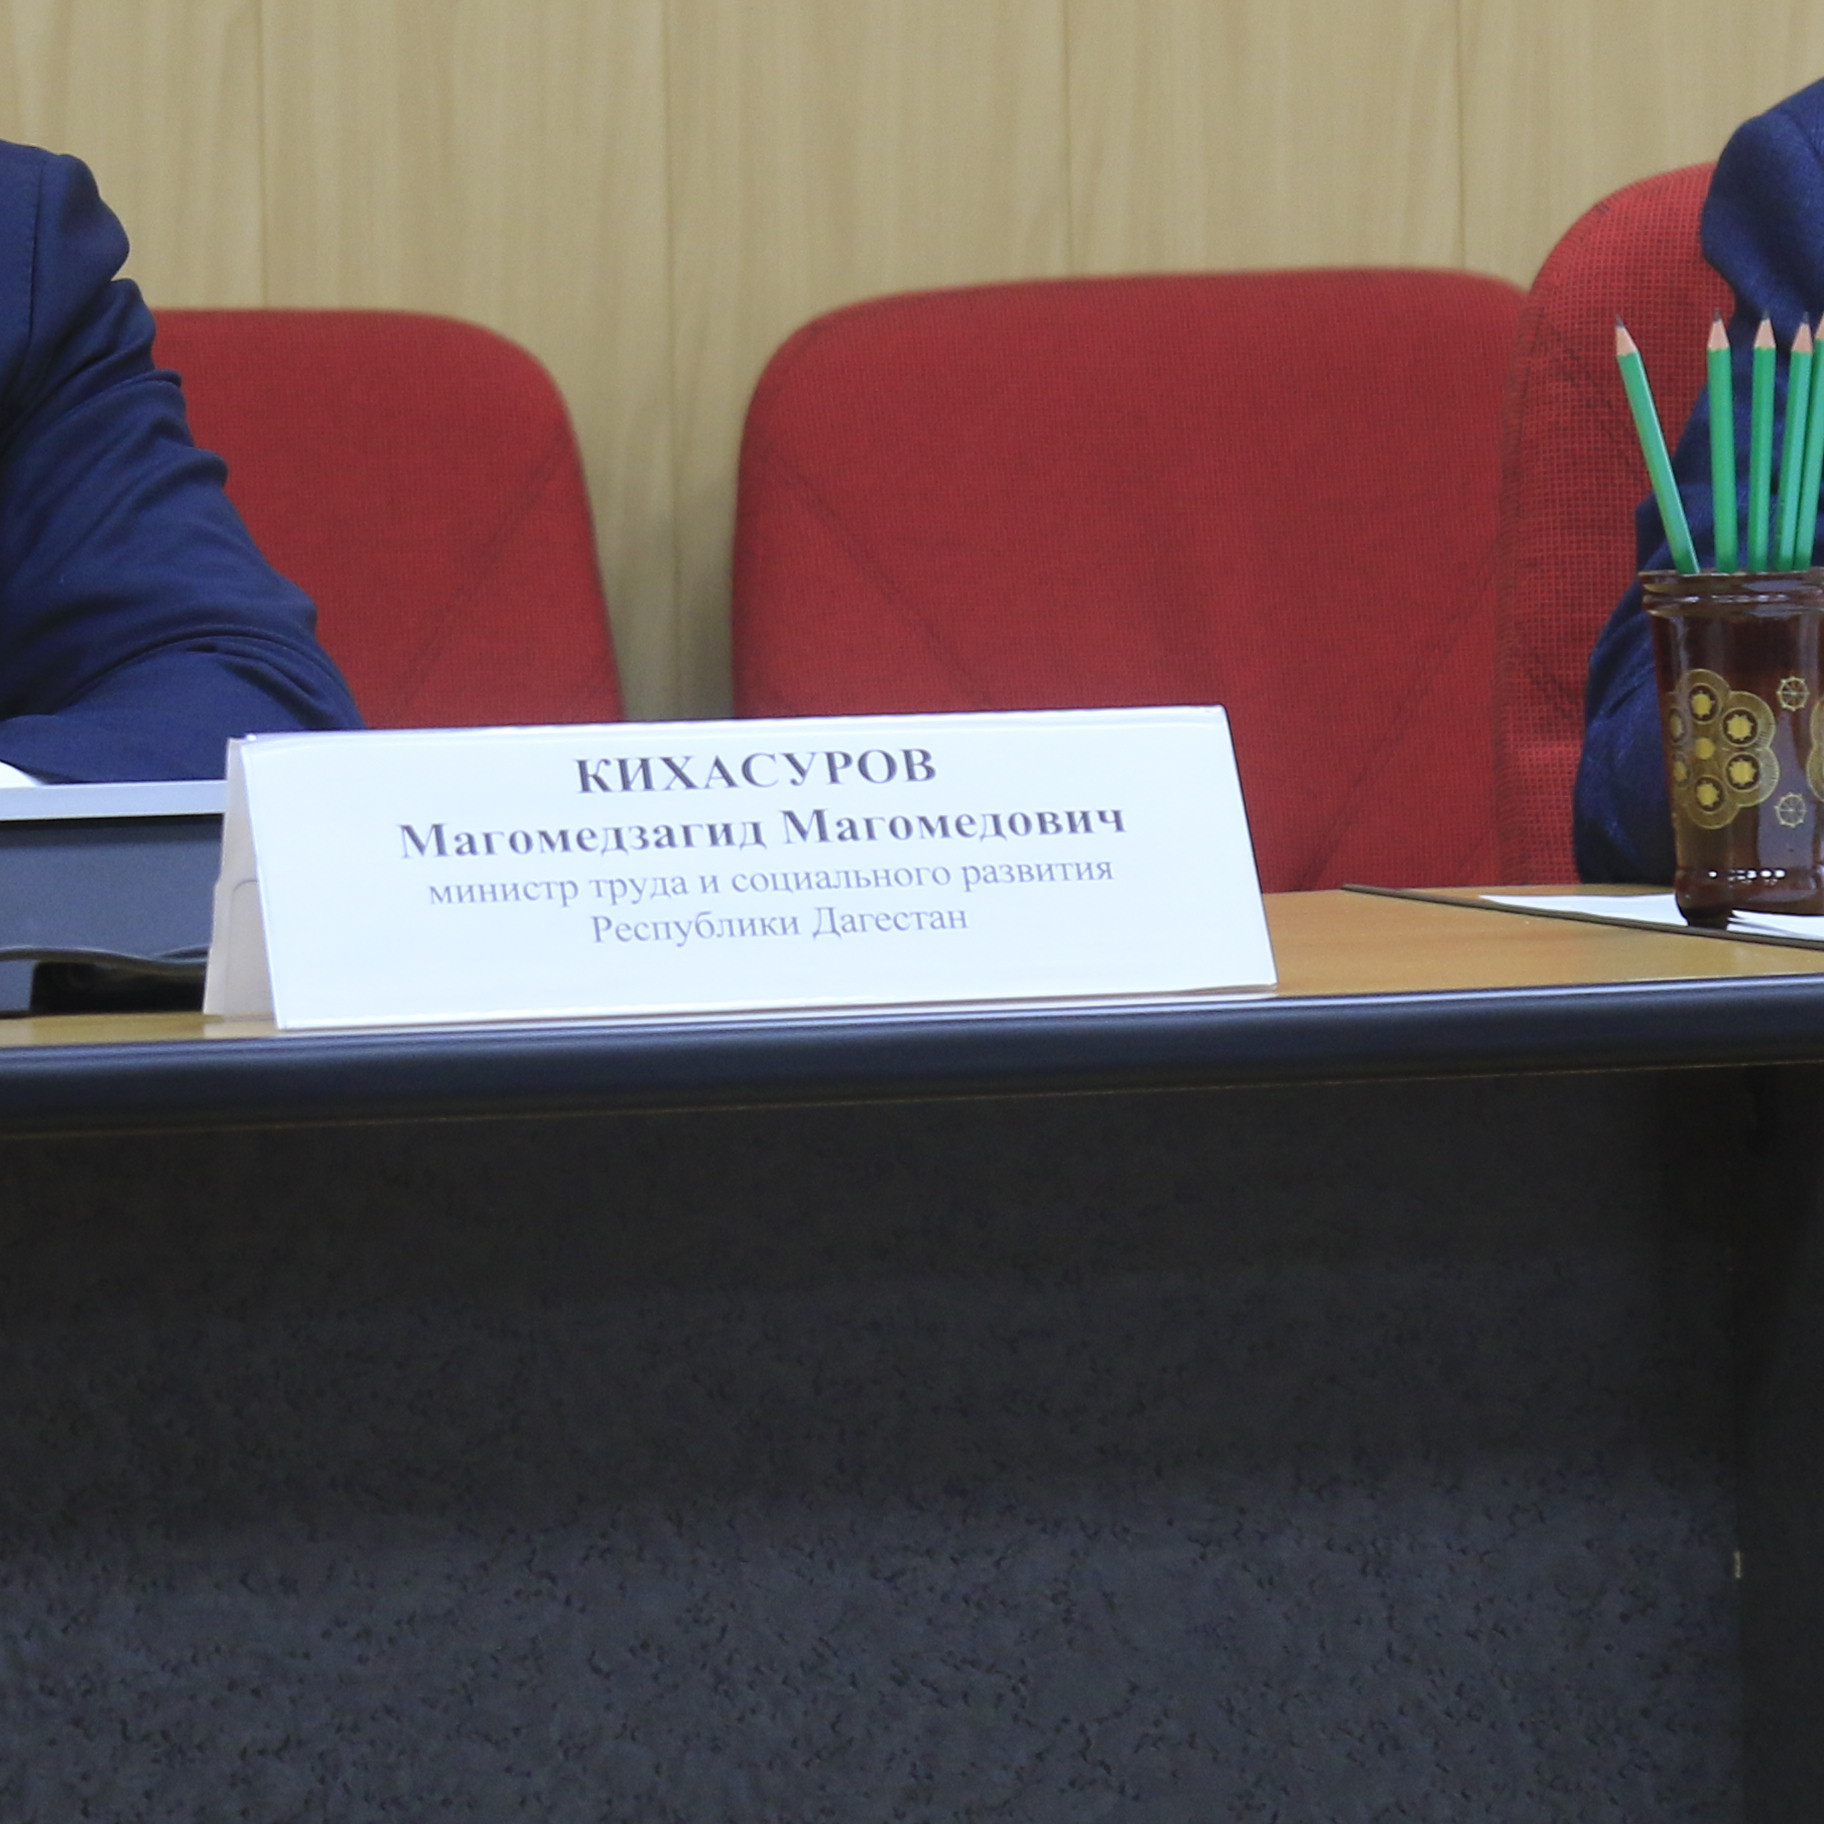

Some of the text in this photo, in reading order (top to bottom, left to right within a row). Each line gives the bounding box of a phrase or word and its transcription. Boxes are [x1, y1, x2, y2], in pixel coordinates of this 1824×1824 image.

[574, 748, 937, 794] КИХАСУРОВ
[398, 808, 1126, 859] Магомедзагид Магомедович
[428, 861, 1114, 908] министр труда и социального развития
[590, 906, 968, 948] Республики Дагестан
